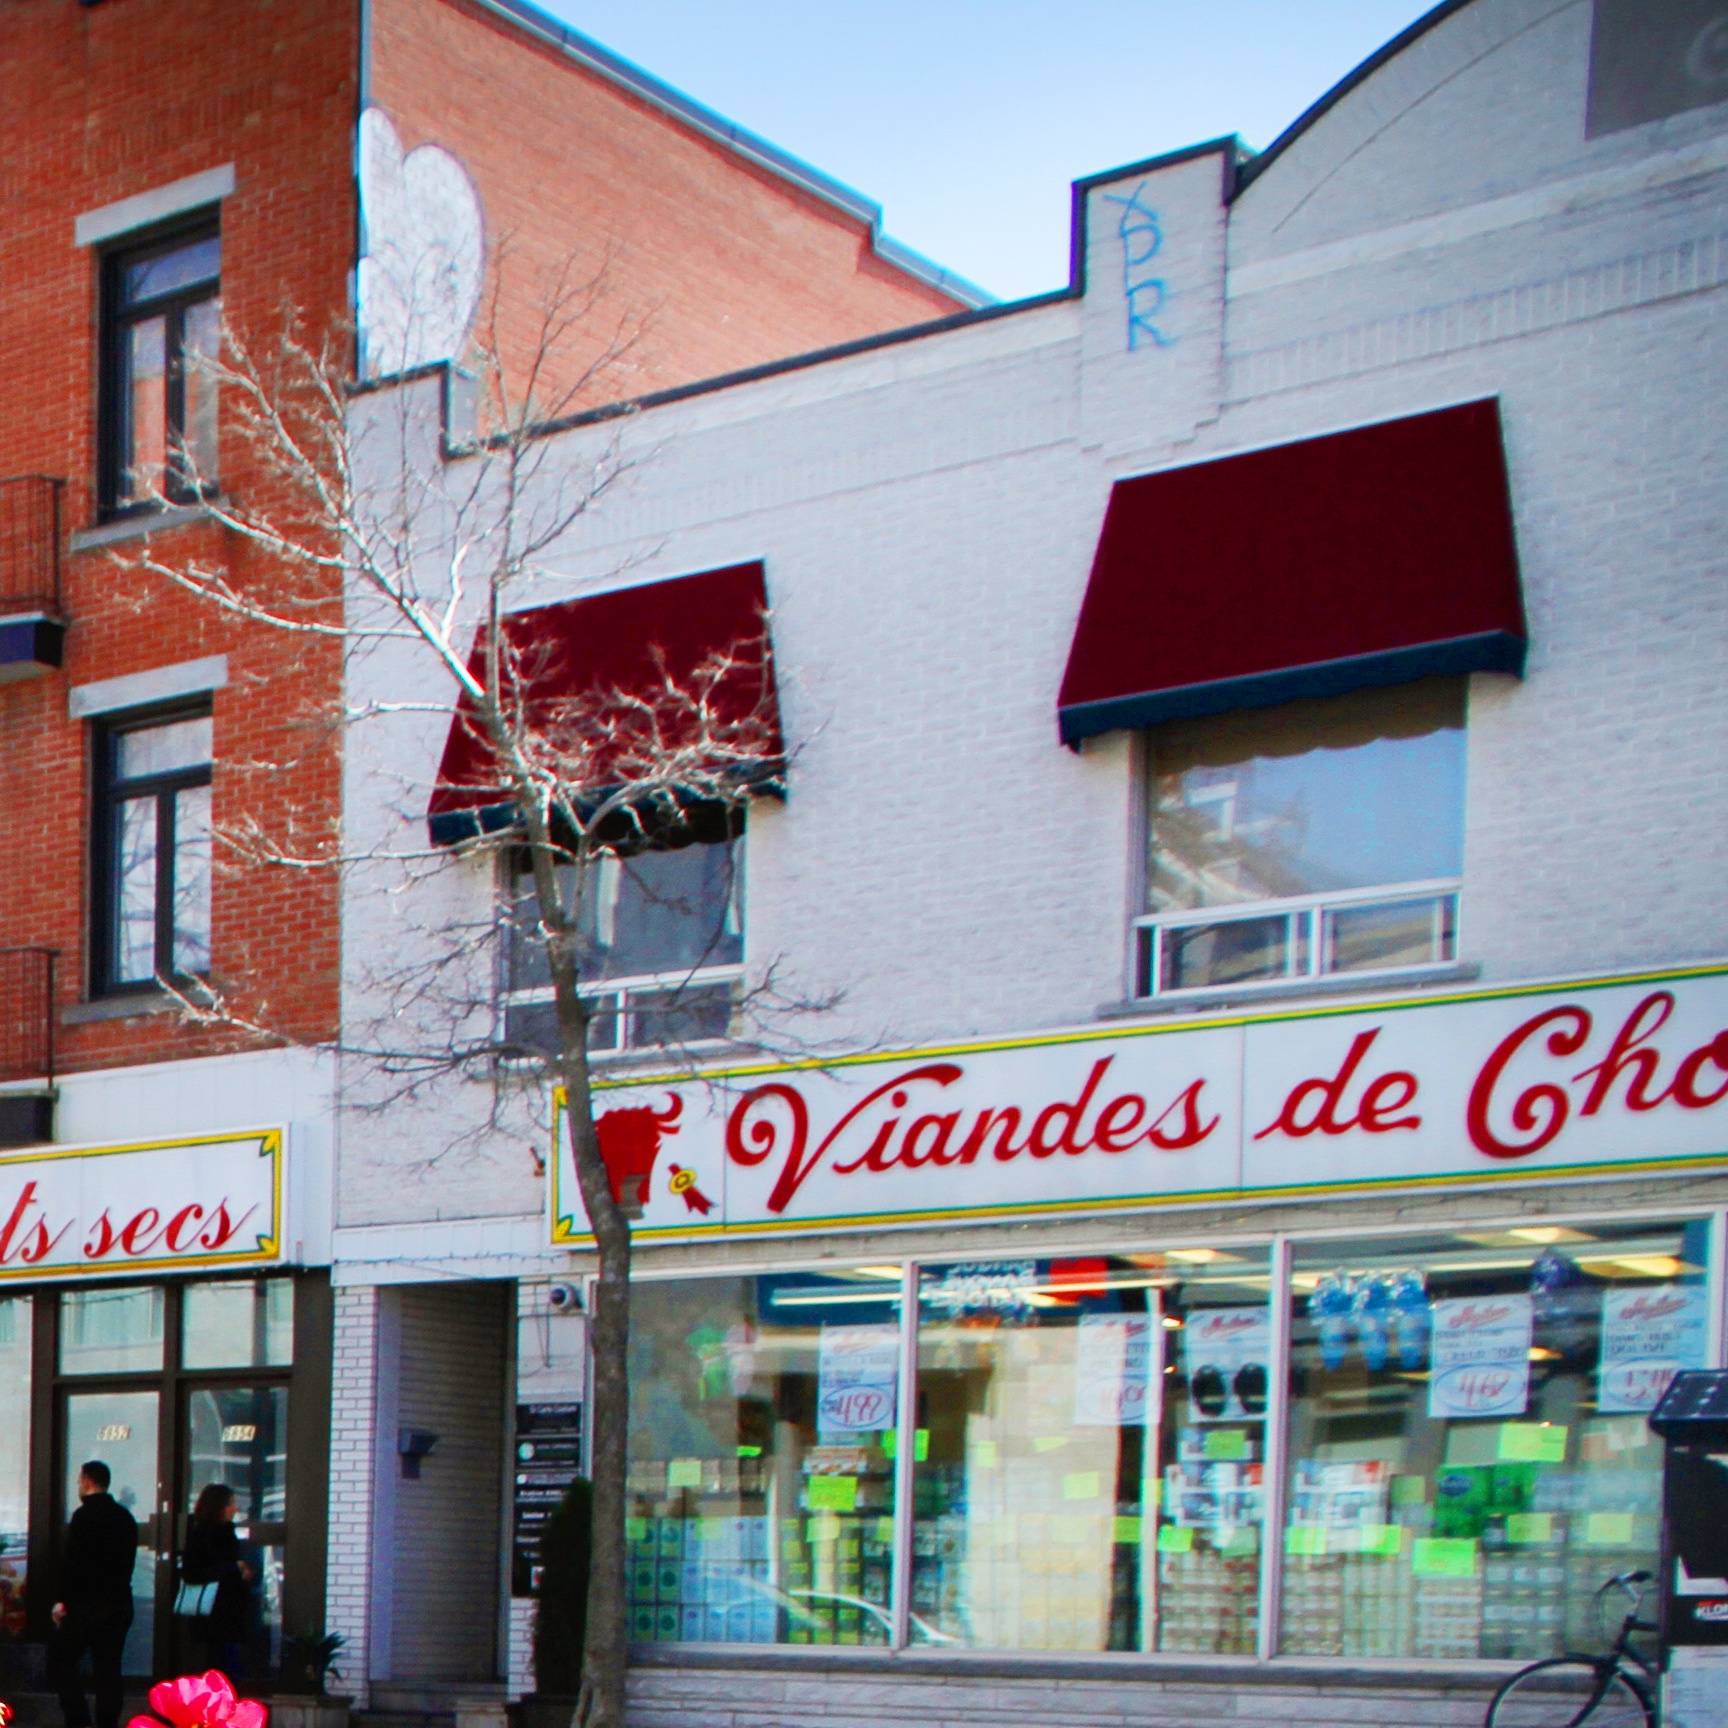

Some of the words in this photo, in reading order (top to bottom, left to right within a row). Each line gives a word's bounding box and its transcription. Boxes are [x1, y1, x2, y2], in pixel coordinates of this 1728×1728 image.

[726, 1053, 1221, 1214] Viandes
[1253, 1025, 1422, 1141] de
[84, 1196, 259, 1259] secs
